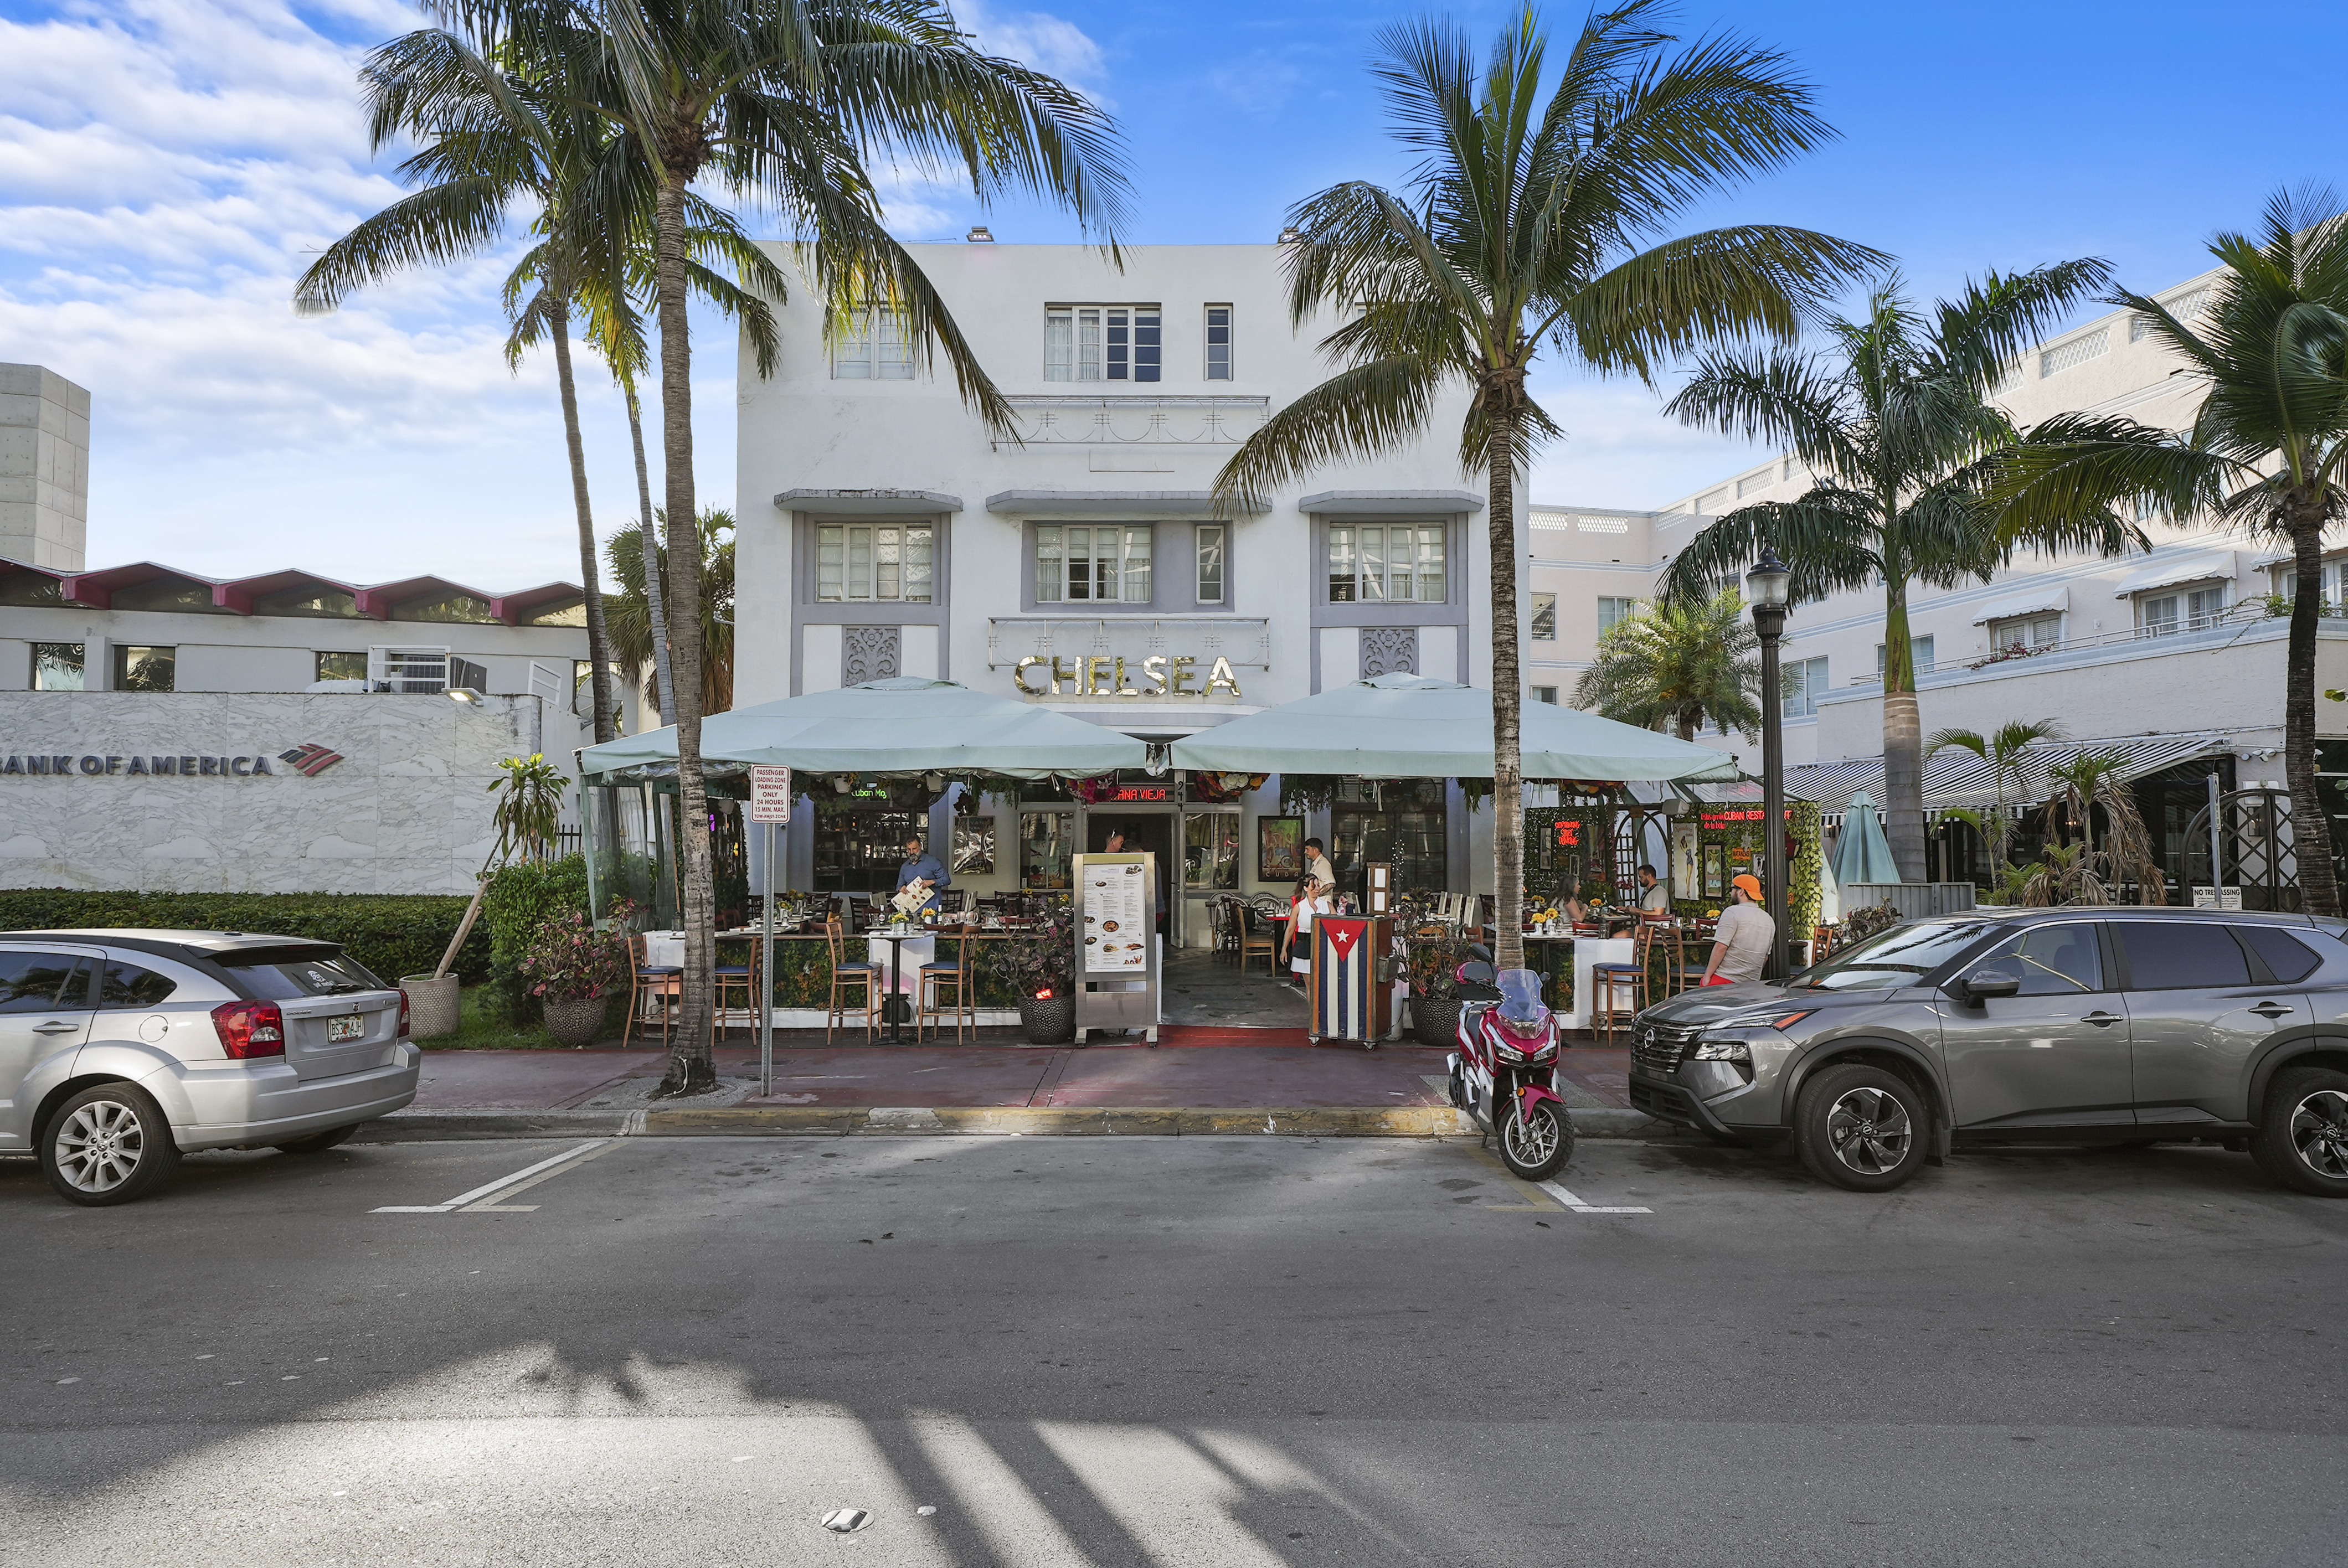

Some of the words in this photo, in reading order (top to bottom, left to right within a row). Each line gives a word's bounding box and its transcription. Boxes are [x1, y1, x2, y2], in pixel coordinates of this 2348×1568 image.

[1014, 656, 1242, 697] CHELSEA
[0, 755, 73, 775] ANK
[80, 755, 122, 775] OF
[127, 756, 272, 775] AMERICA
[1140, 788, 1166, 801] VIEJA
[1724, 811, 1744, 820] CUBAN
